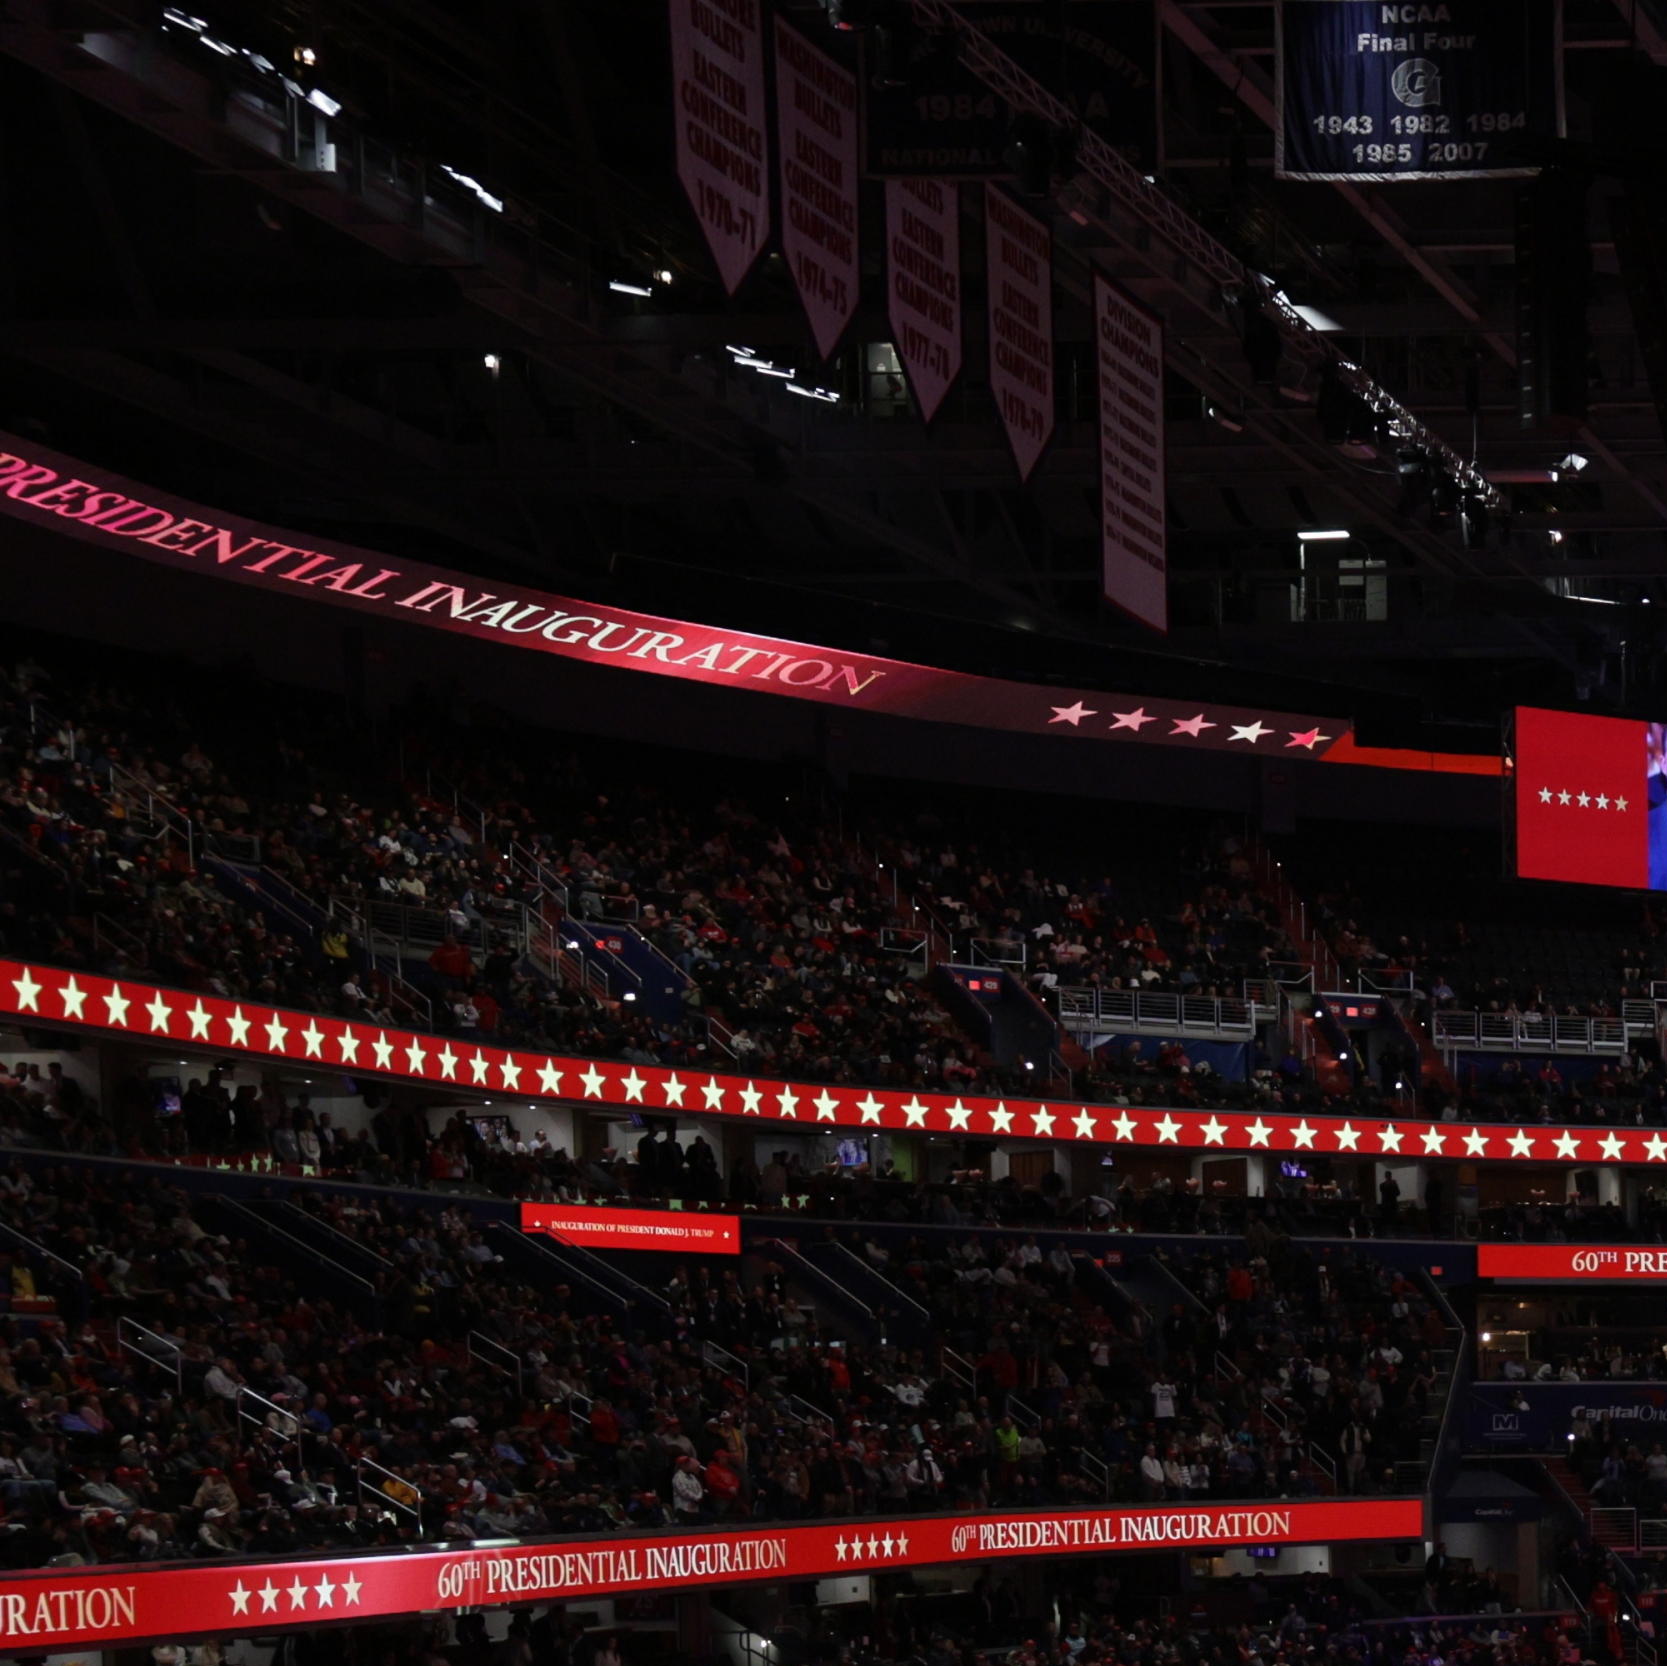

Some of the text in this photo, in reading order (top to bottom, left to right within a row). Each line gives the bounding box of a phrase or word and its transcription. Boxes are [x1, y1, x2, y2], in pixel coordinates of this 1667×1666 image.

[1381, 5, 1452, 25] NCAA
[1356, 33, 1477, 53] Final Four
[1313, 112, 1529, 135] 1943 1982 1984
[1352, 142, 1489, 163] 1985 2007
[0, 453, 886, 696] PRESIDENTIAL INAUGURATION
[551, 1220, 714, 1238] INAUGURATION OF PRESIDENT DONALD J. TRUMP
[1571, 1251, 1618, 1273] 60TH
[951, 1511, 1291, 1554] 60TH PRESIDENTIAL INAUGURATION
[437, 1538, 787, 1600] 60TH PRESIDENTIAL INAUGURATION
